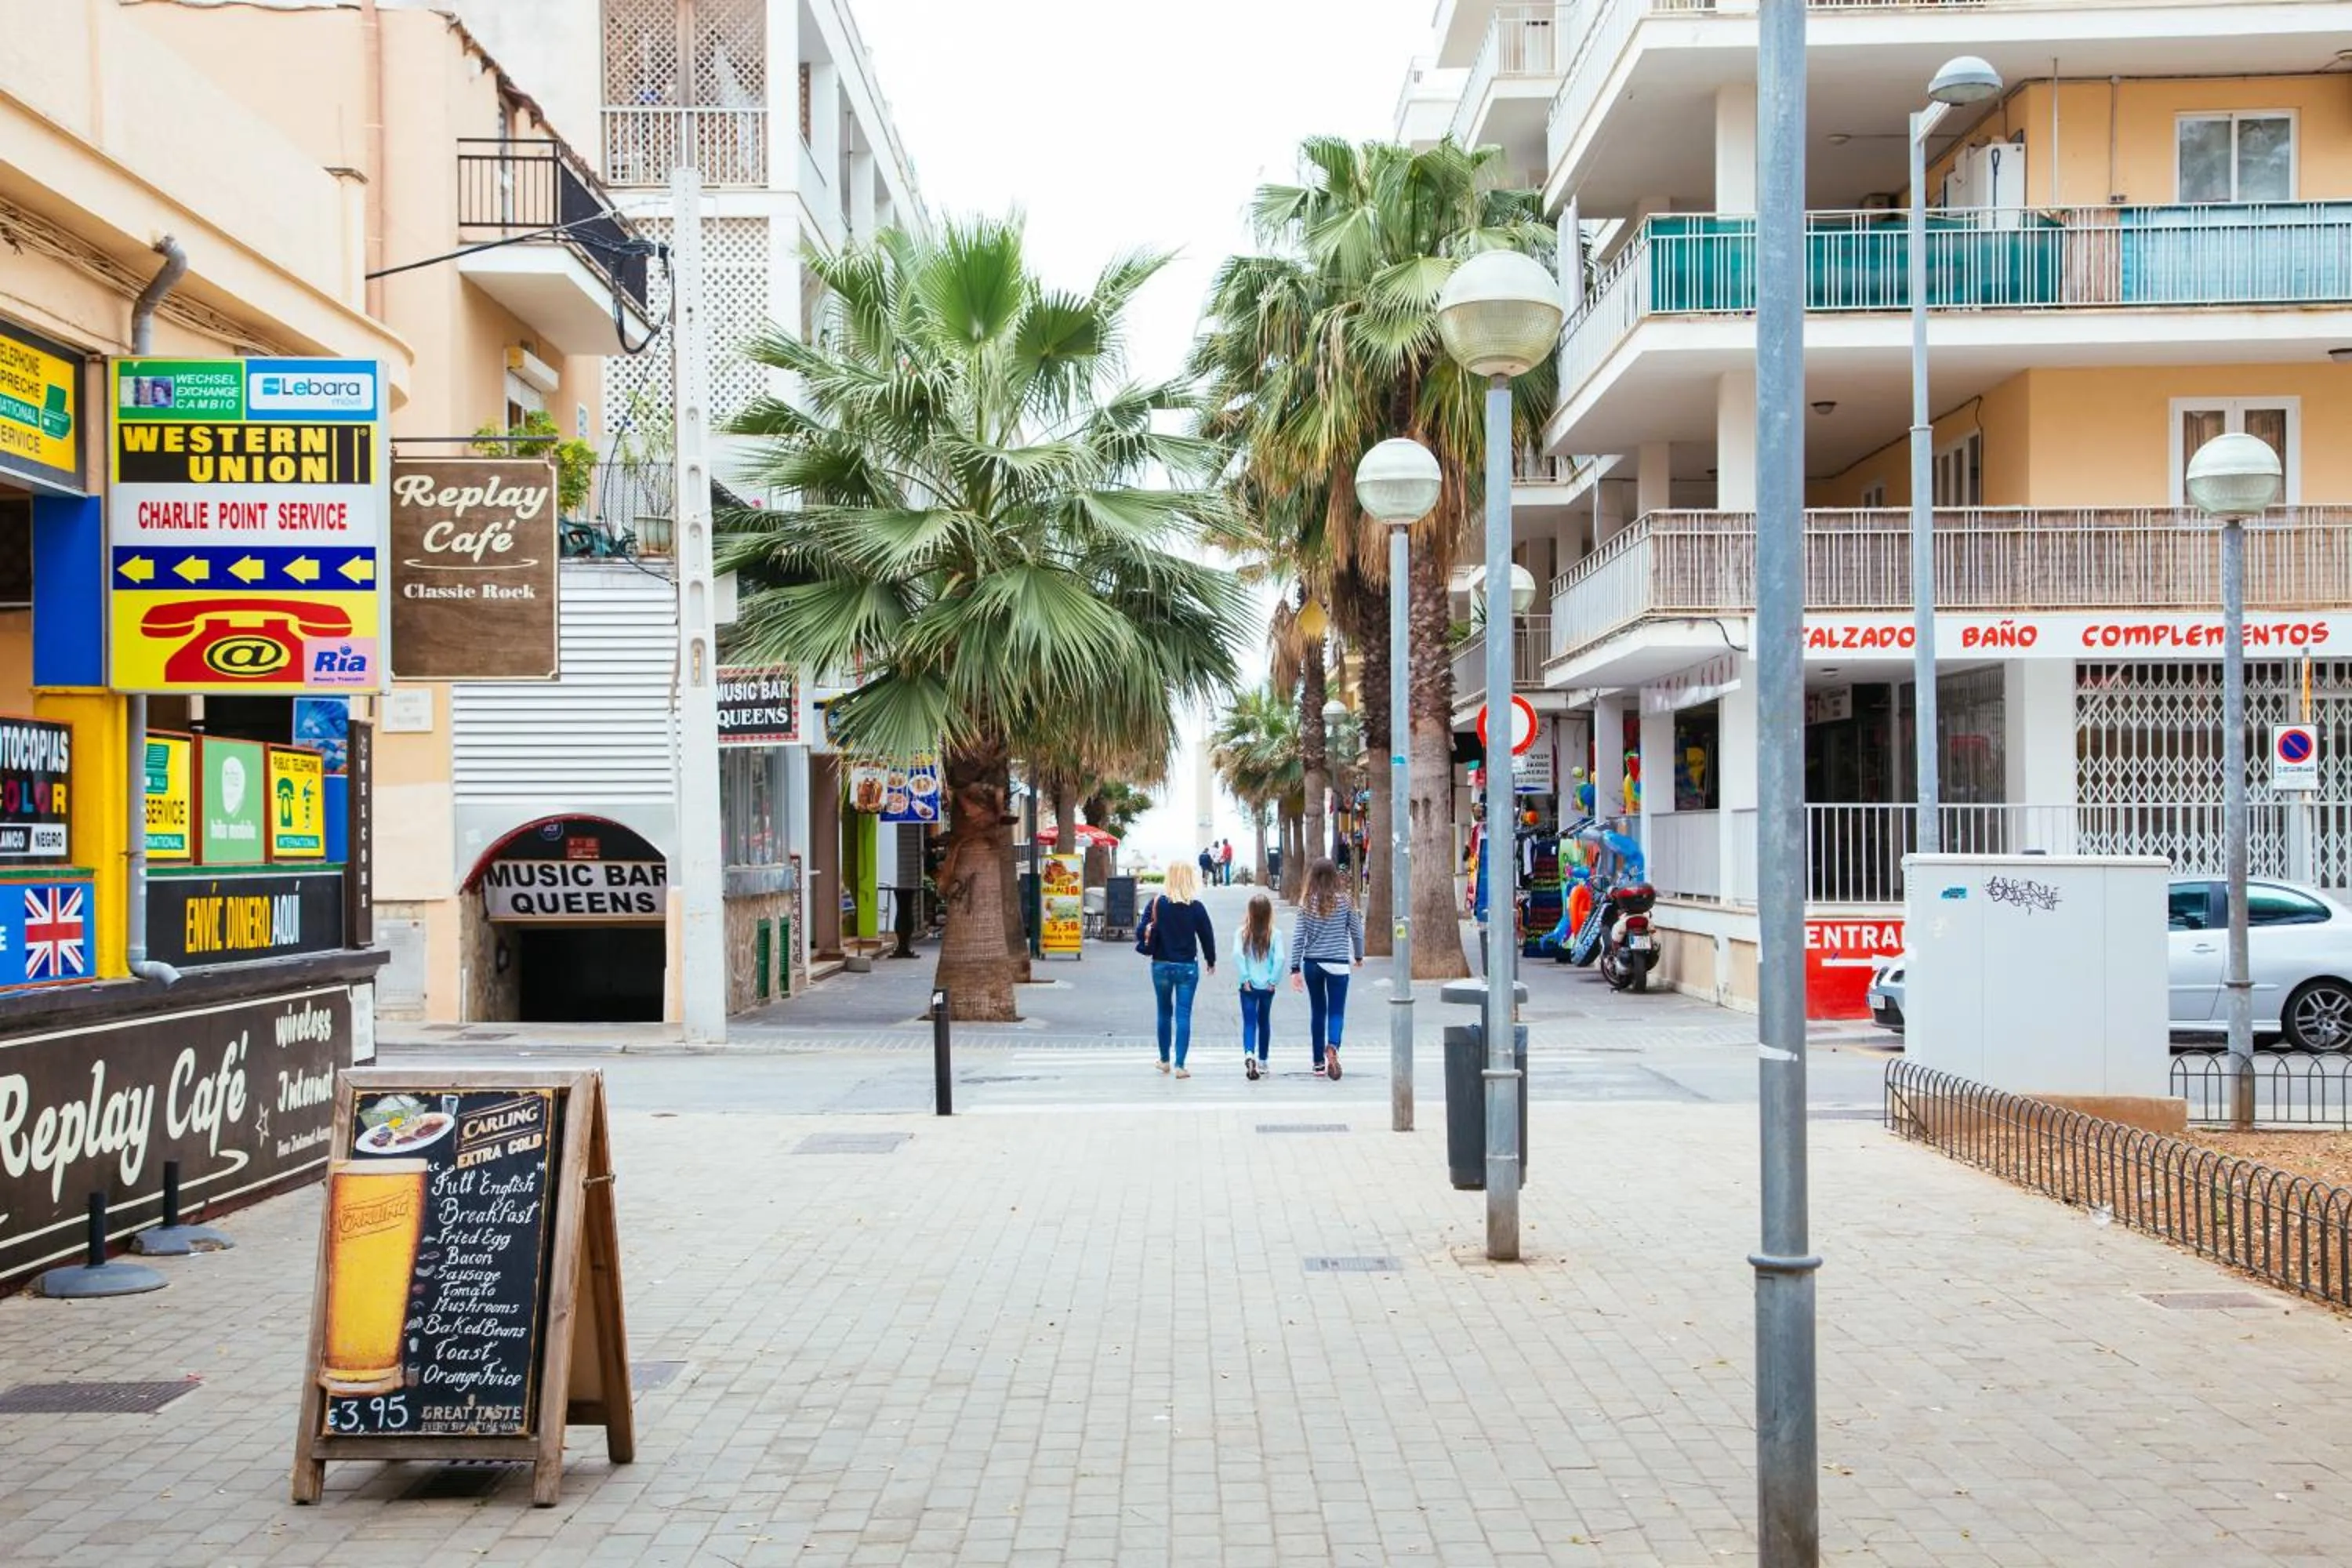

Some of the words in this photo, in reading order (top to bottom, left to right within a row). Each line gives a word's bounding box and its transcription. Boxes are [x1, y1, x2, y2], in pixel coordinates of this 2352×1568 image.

[176, 374, 237, 385] WECHSEL
[176, 387, 239, 397] EXCHANGE
[281, 377, 361, 396] Lebara
[176, 398, 236, 409] CAMBIO
[122, 426, 328, 452] WESTERN
[188, 456, 328, 483] UNION
[393, 474, 549, 520] Replay
[138, 501, 209, 530] CHARLIE
[219, 502, 269, 530] POINT
[278, 502, 348, 531] SERVICE
[423, 518, 517, 564] Café
[404, 583, 477, 599] Classic
[482, 583, 536, 599] Rock
[1802, 626, 1916, 648] ALZADO
[1962, 619, 2038, 648] BAÑO
[314, 644, 367, 673] Ria
[717, 706, 789, 728] QUEENS
[0, 725, 69, 774] TOCOPIAS
[0, 779, 67, 815] OLOR
[34, 831, 64, 848] NEGRO
[487, 863, 593, 887] MUSIC
[604, 864, 666, 887] BAR
[510, 891, 656, 916] QUEENS
[1804, 924, 1905, 949] ENTRA
[165, 1029, 249, 1158] Café
[462, 1105, 539, 1138] CARLING
[456, 1145, 503, 1169] EXTRA
[508, 1133, 543, 1155] COLD
[479, 1169, 536, 1202] English
[436, 1225, 482, 1245] Fried
[481, 1228, 511, 1252] Egg
[445, 1246, 494, 1265] Bacon
[434, 1265, 502, 1282] Sausage
[440, 1280, 497, 1298] Tomato
[431, 1296, 521, 1314] Mushrooms
[435, 1334, 499, 1360] Toast
[421, 1405, 472, 1421] GREAT
[474, 1404, 522, 1421] TASTE
